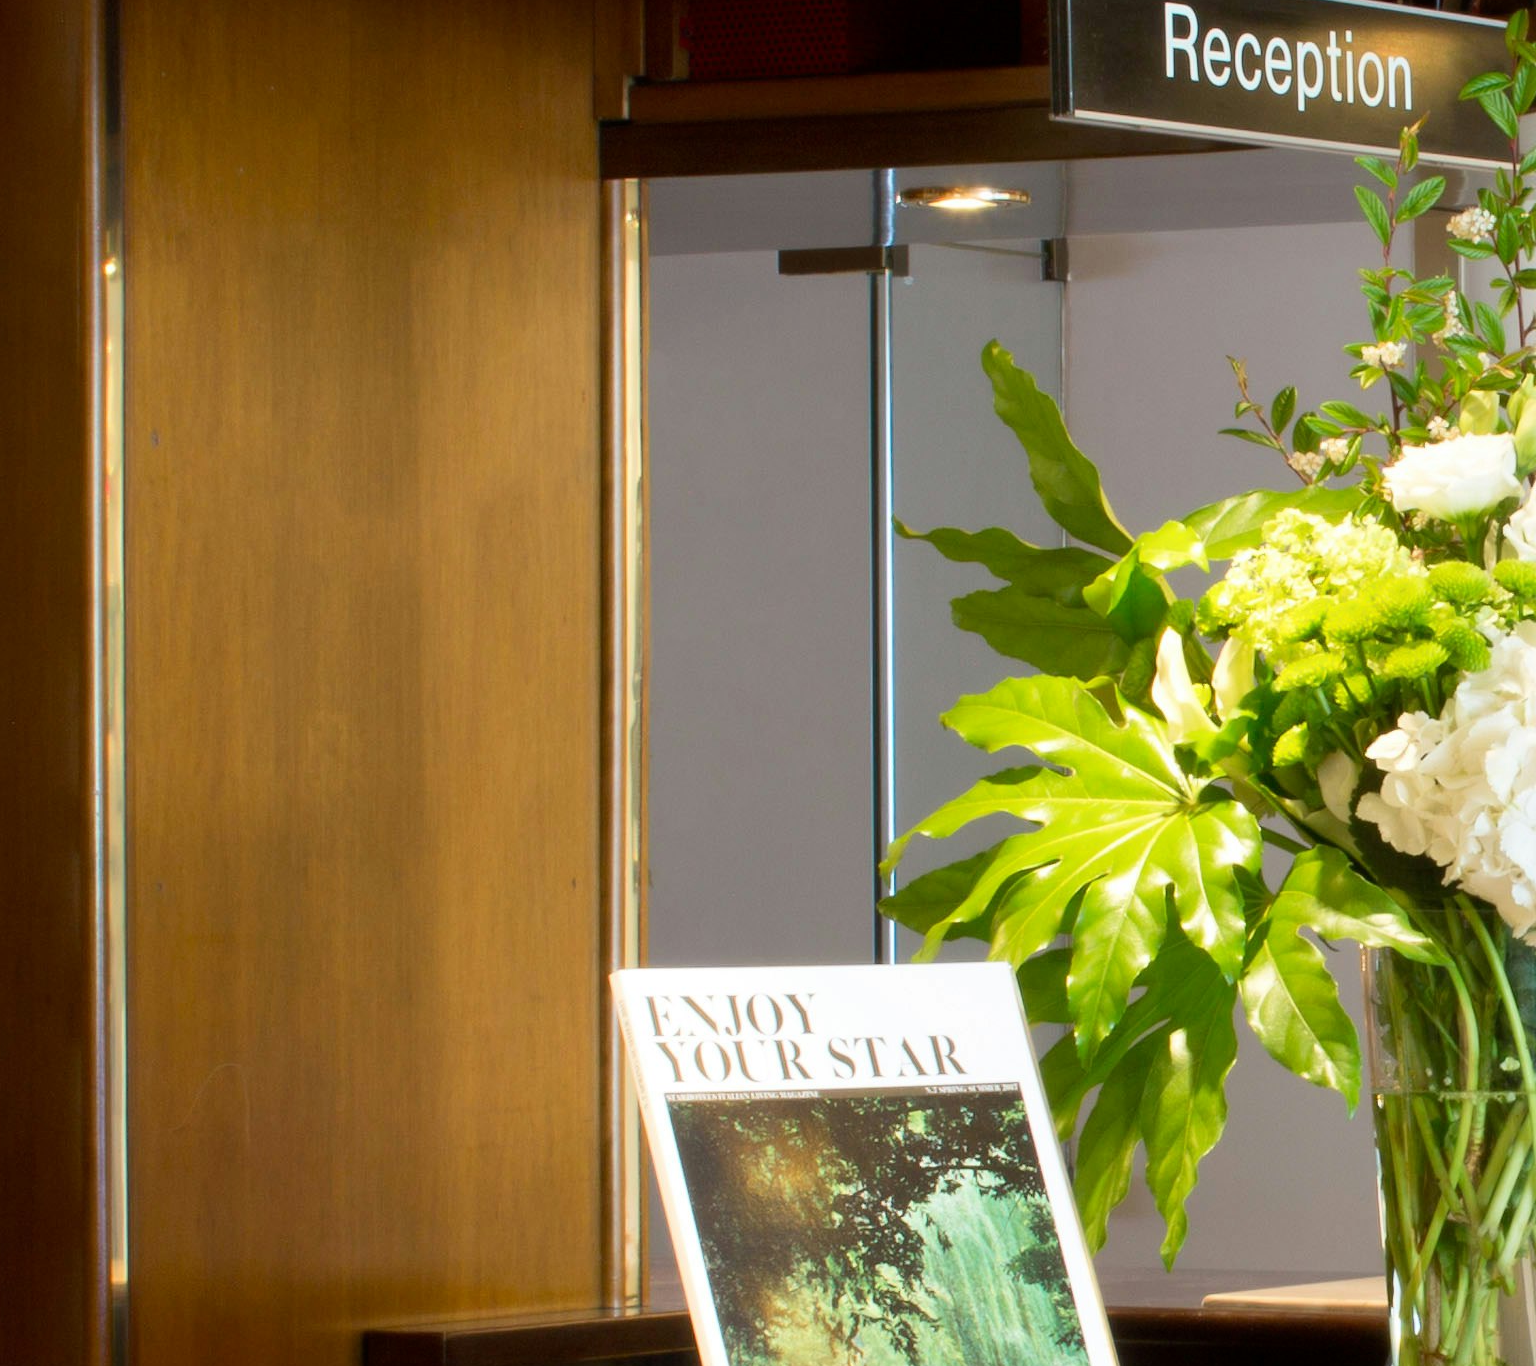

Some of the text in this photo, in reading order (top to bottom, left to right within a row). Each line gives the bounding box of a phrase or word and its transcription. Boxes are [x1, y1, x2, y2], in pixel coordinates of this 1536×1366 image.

[1164, 2, 1412, 111] Reception
[646, 993, 816, 1037] ENJOY
[656, 1034, 968, 1083] YOUR STAR
